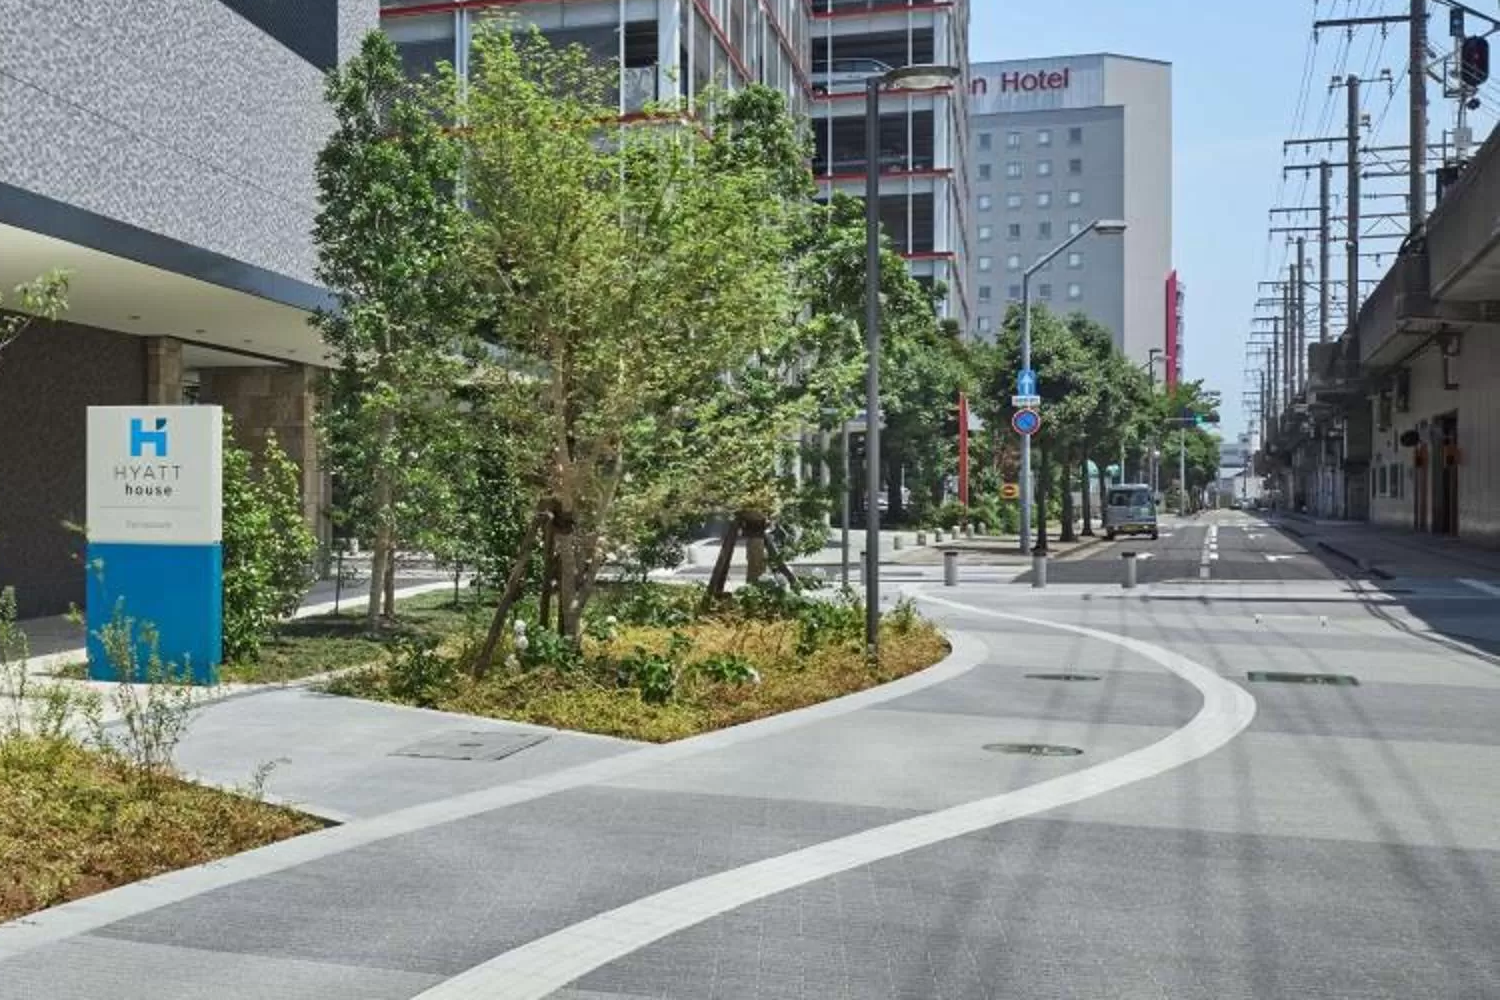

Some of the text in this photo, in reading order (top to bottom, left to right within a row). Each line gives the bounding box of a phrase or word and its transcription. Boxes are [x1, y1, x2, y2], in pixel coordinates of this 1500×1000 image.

[1001, 67, 1070, 93] Hotel
[114, 465, 182, 481] HYATT
[125, 484, 173, 497] house
